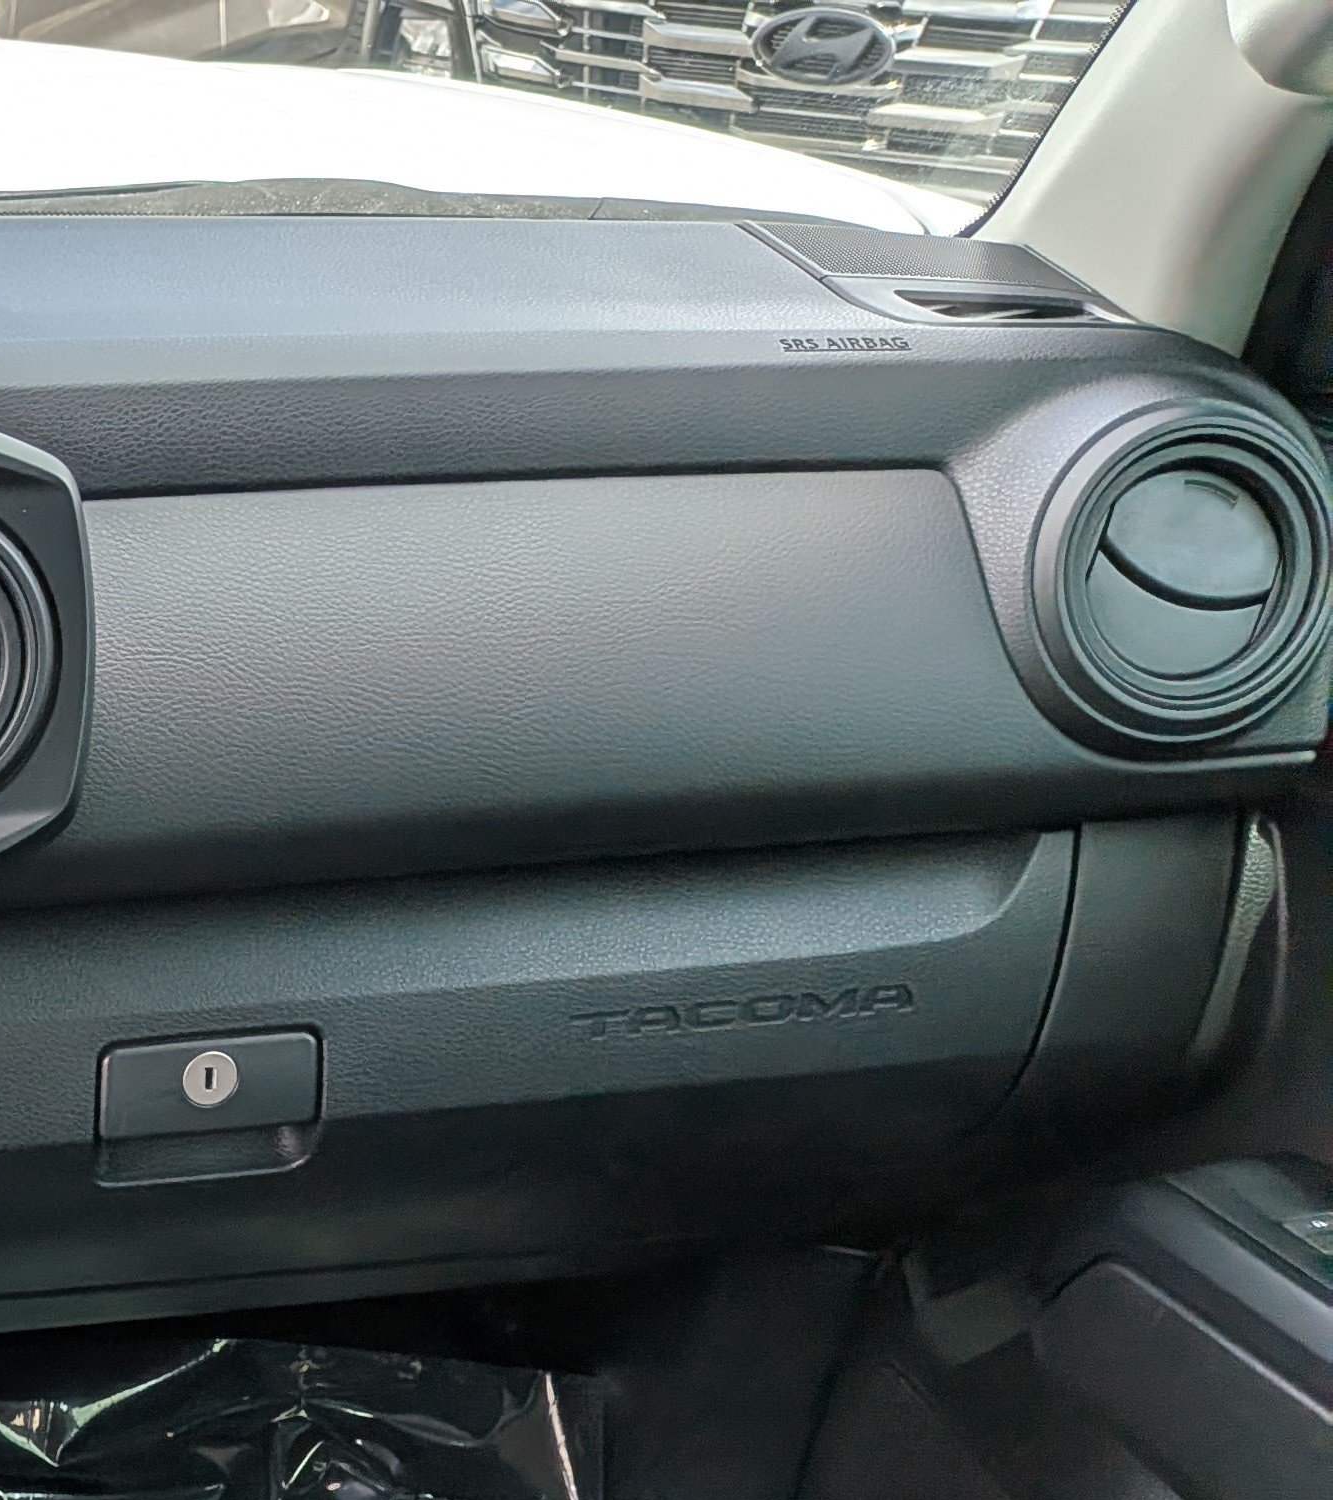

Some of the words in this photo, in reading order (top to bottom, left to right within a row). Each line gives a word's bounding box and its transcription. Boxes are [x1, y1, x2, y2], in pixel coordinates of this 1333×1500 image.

[779, 338, 819, 350] SRS
[826, 337, 910, 350] AIRBAG
[569, 983, 915, 1041] TACOMA
